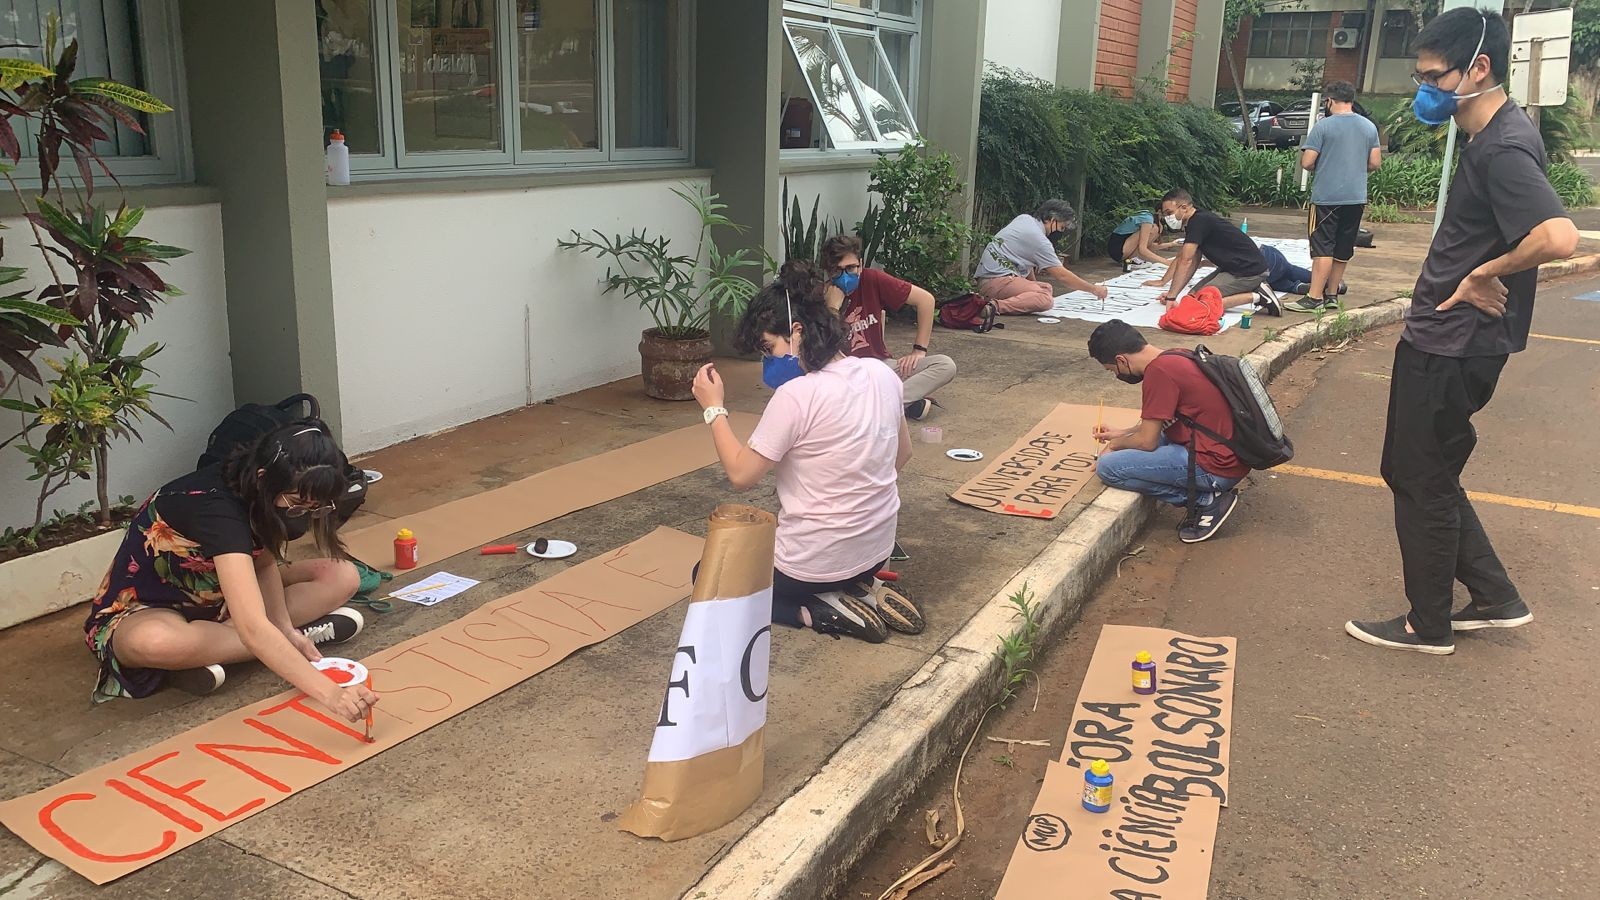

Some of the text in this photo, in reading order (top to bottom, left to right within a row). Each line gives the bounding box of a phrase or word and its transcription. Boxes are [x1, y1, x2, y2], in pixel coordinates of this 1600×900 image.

[1014, 475, 1079, 505] PARA
[1066, 701, 1142, 768] ORA
[1142, 637, 1230, 804] BOLSONARO
[1028, 817, 1060, 847] MUP
